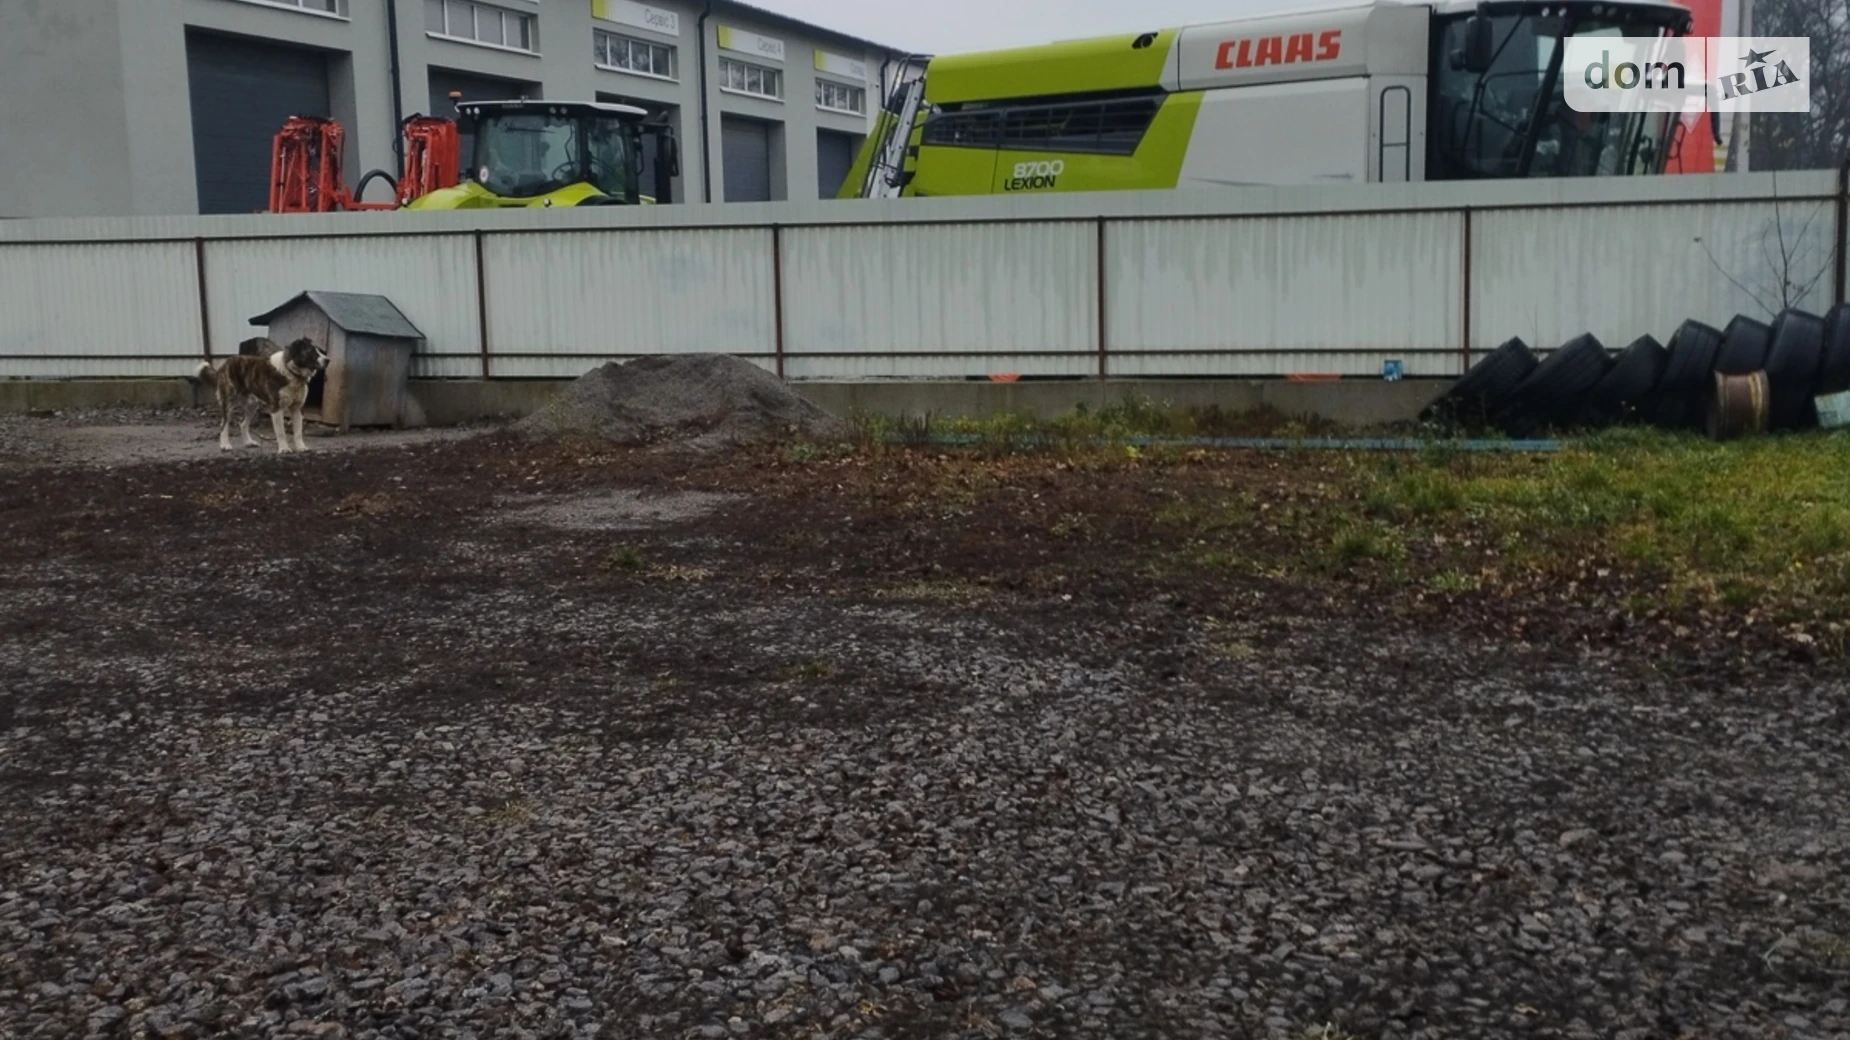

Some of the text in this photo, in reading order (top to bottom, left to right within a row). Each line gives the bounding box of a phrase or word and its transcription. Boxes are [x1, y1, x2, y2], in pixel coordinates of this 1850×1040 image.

[670, 14, 676, 29] 3
[1215, 29, 1342, 70] CLAAS
[1013, 160, 1065, 178] 8700
[1004, 175, 1056, 192] LEXION
